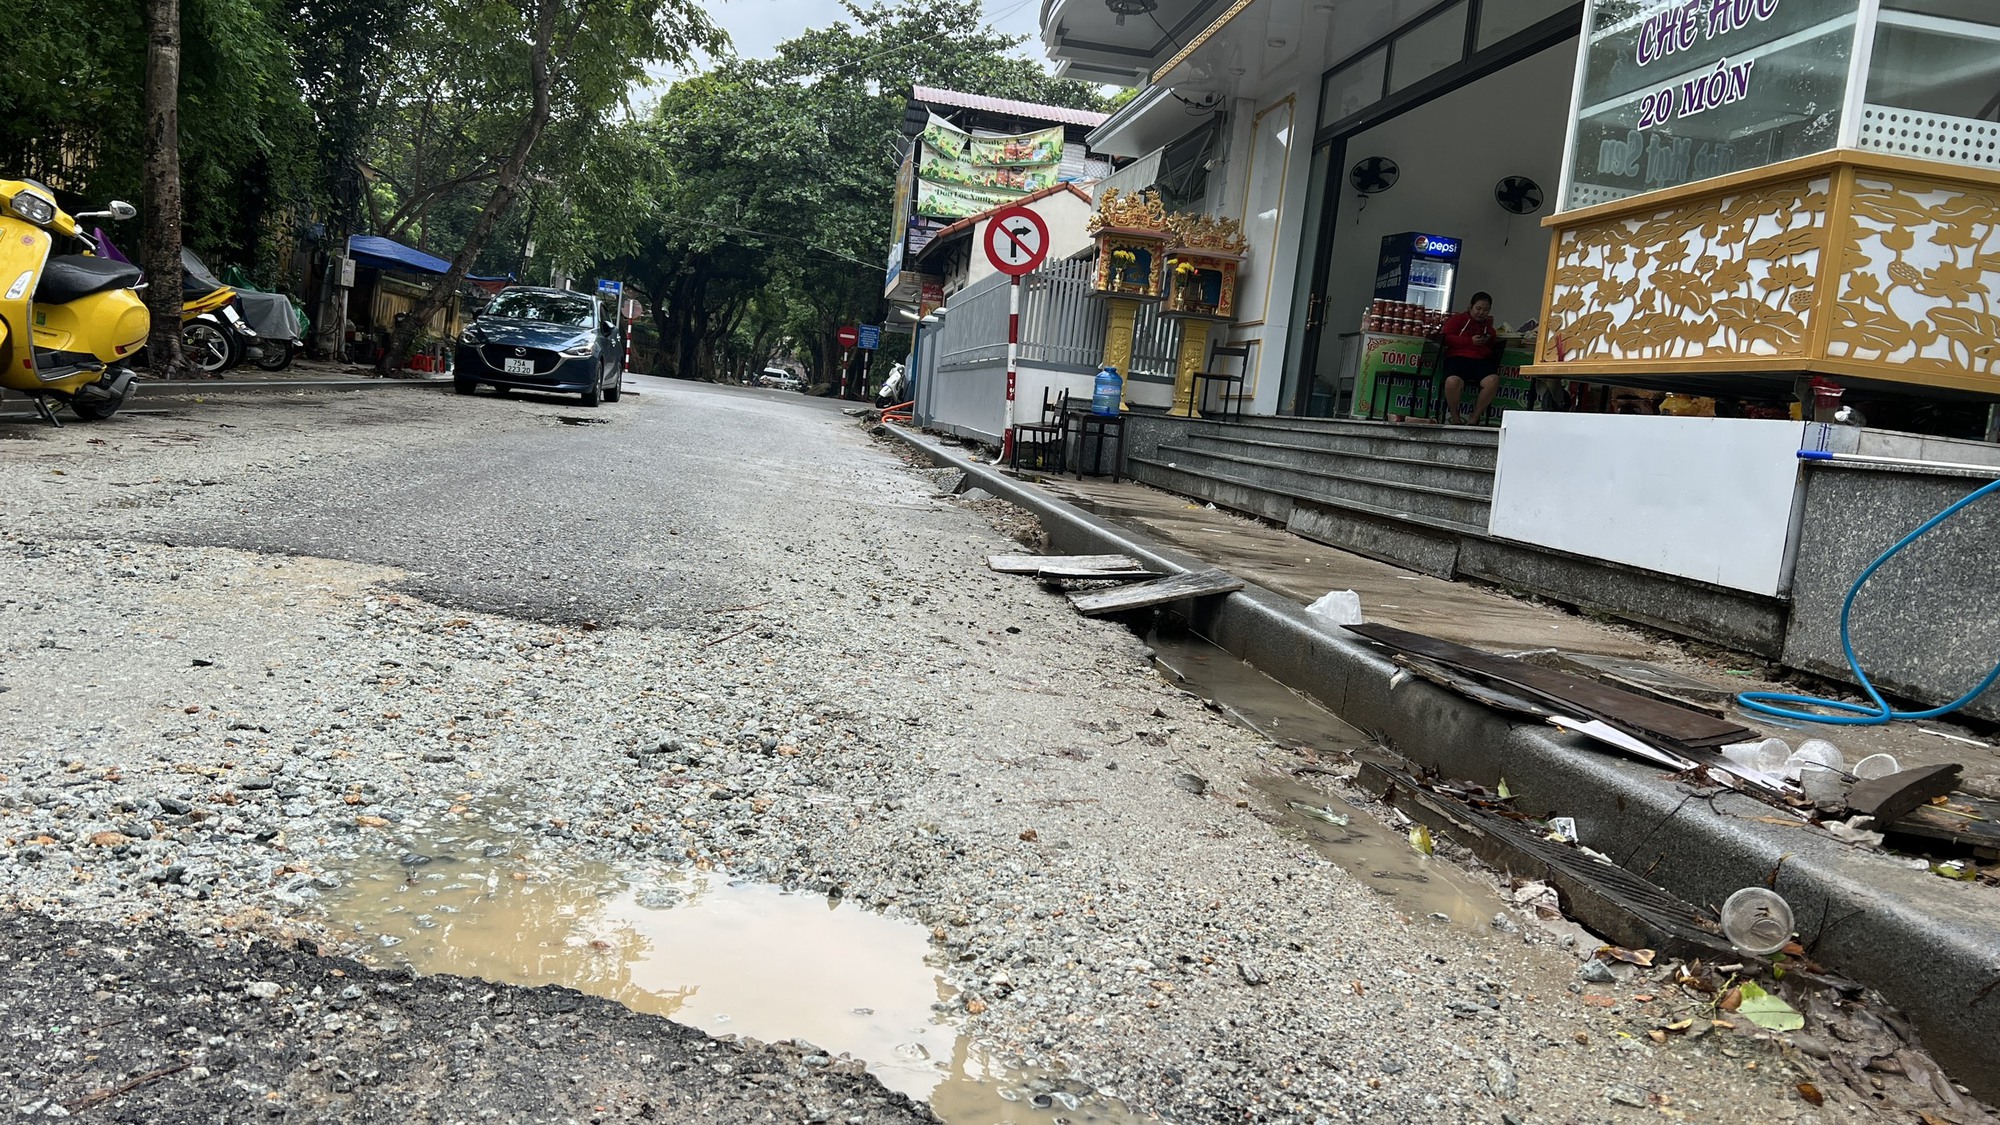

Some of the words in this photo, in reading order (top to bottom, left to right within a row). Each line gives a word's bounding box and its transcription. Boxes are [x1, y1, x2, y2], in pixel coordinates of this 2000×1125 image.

[1638, 86, 1674, 130] 20
[1678, 57, 1754, 118] MÓN
[1428, 241, 1458, 253] pepsi
[1381, 349, 1406, 366] TÔM
